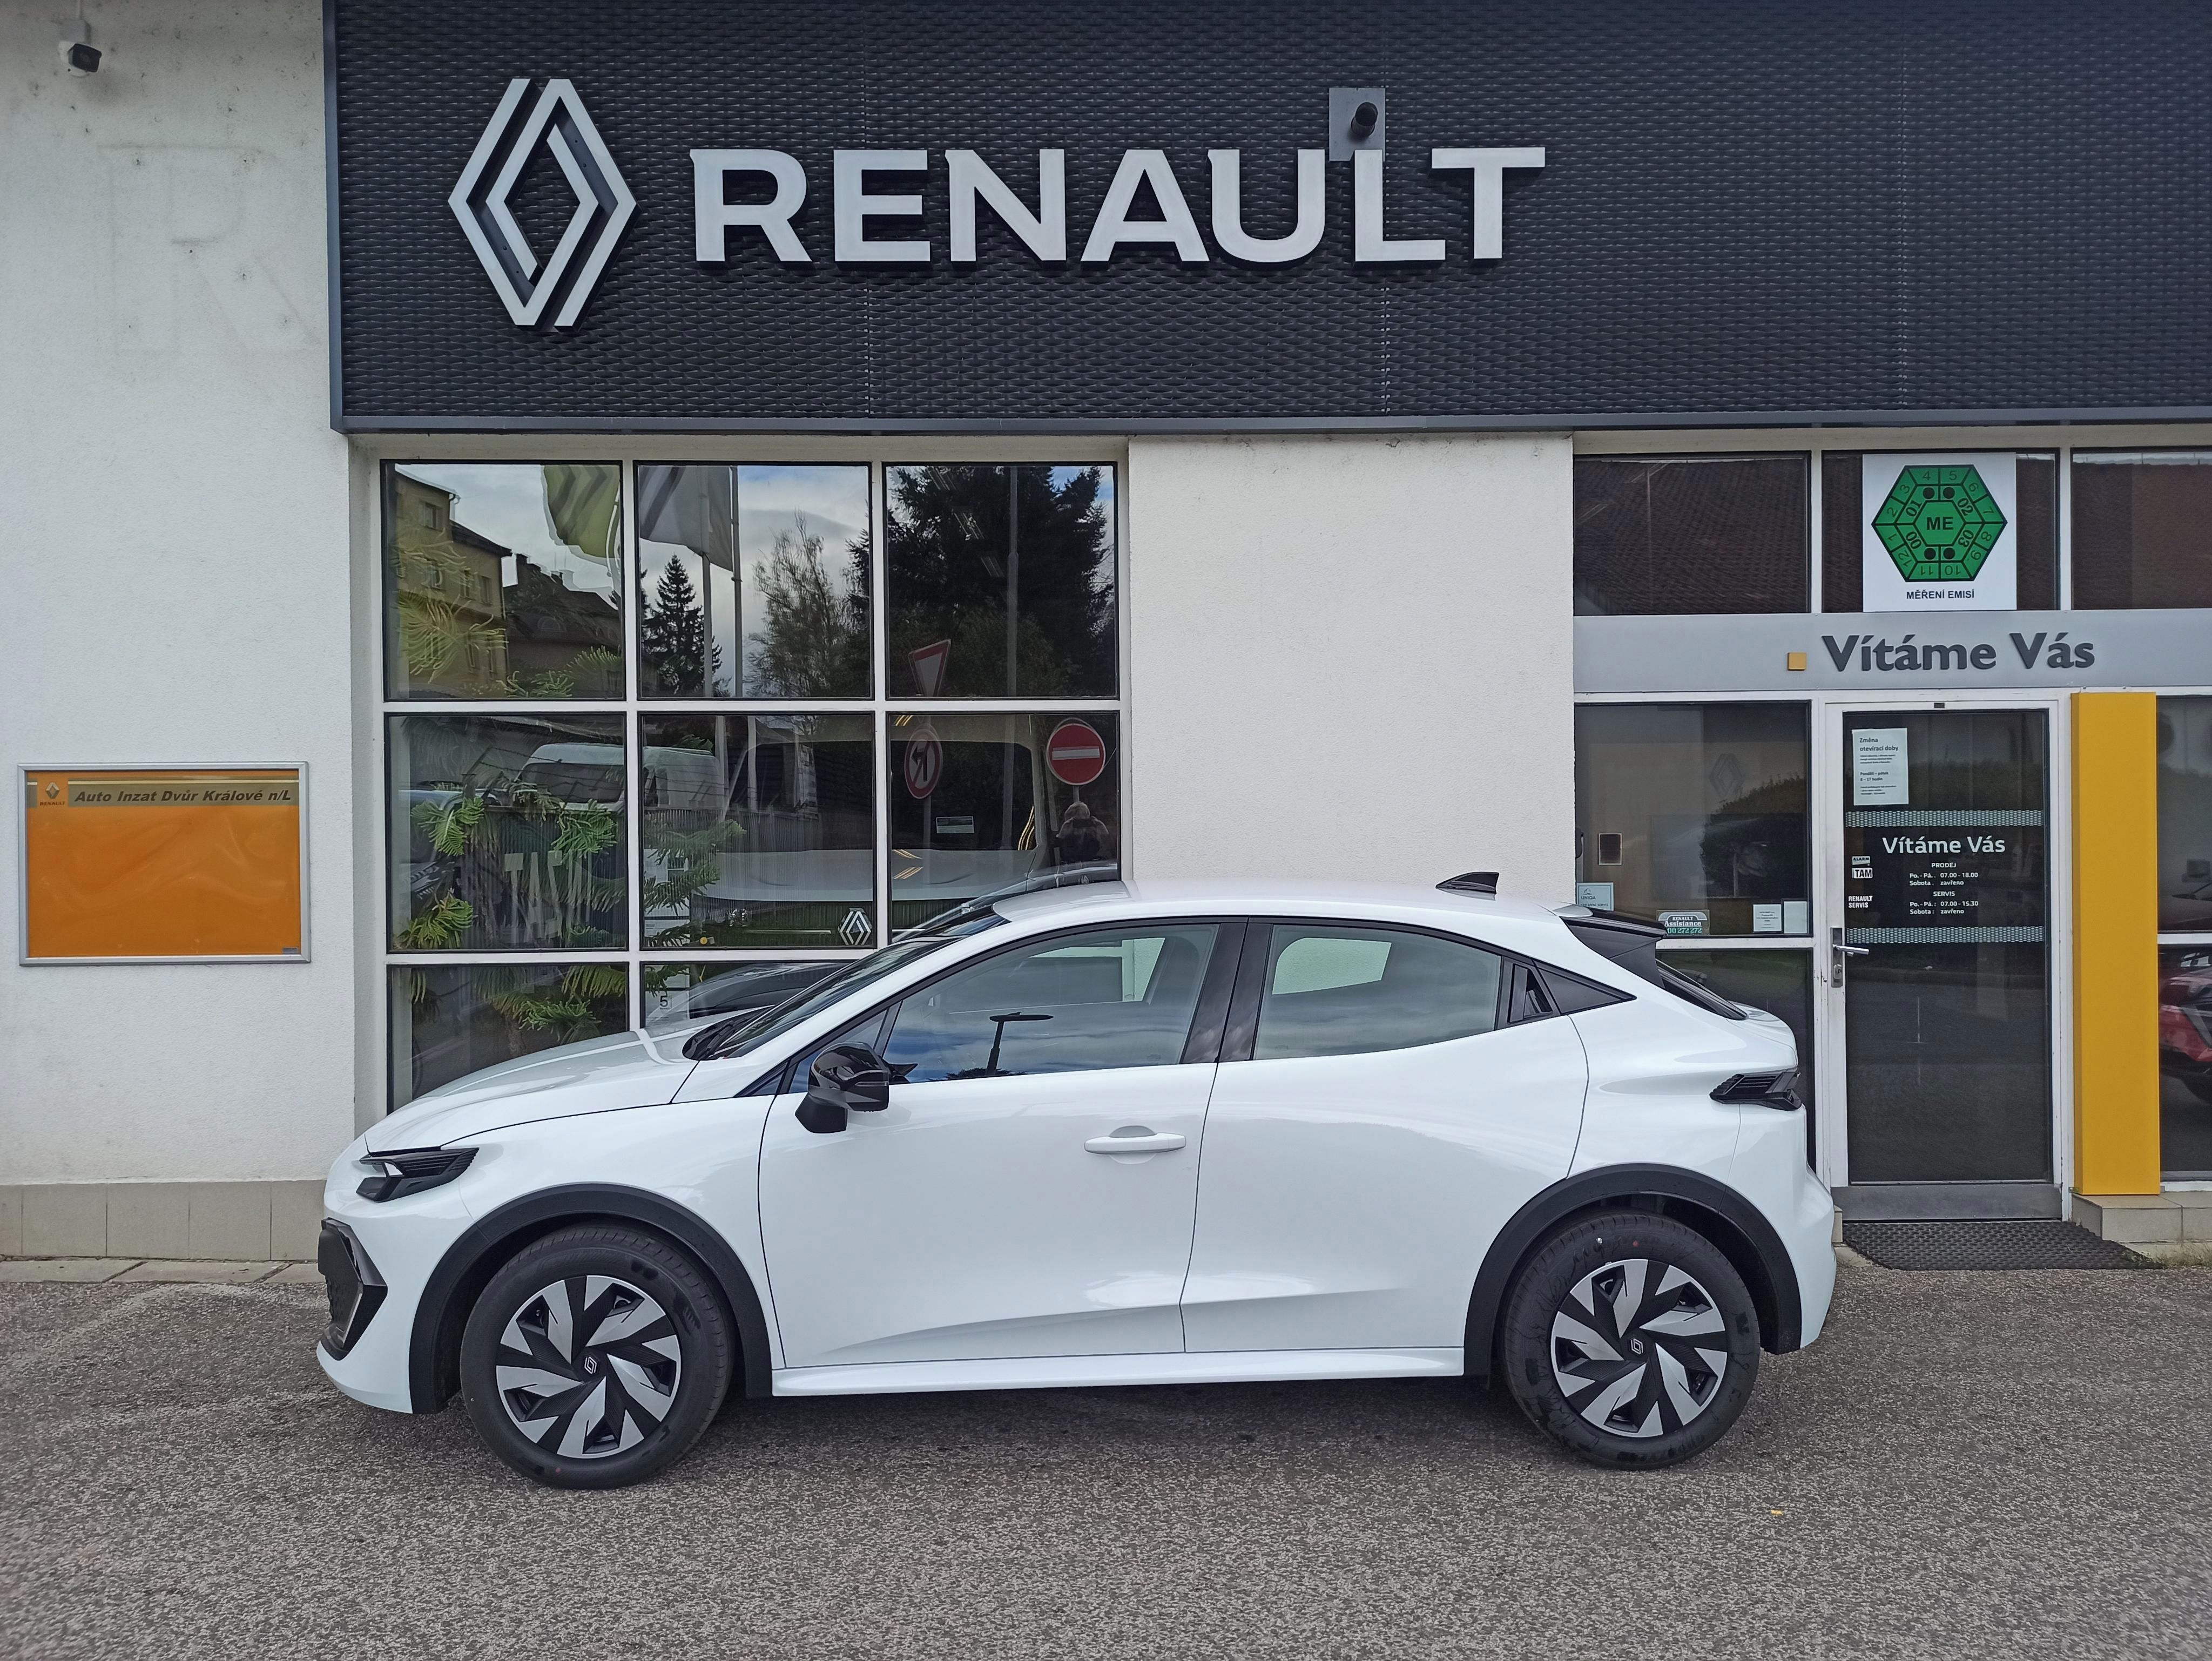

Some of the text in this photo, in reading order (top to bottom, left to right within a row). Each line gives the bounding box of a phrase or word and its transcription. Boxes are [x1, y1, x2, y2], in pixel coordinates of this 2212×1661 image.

[690, 147, 1546, 263] RENAULT
[1923, 471, 1931, 481] 4
[1949, 471, 1957, 481] 5
[1900, 484, 1910, 494] 3
[1887, 507, 1898, 517] 2
[1957, 498, 1973, 516] 02
[1983, 505, 1994, 514] 7
[1927, 516, 1953, 530] ME
[1905, 531, 1921, 549] 00
[1958, 530, 1974, 548] 03
[1981, 531, 1992, 541] 8
[1898, 550, 1912, 567] 12
[1921, 566, 1933, 576] 11
[1945, 565, 1961, 576] 10
[1906, 589, 1974, 599] MĚŘENÍ EMISÍ
[1821, 632, 2095, 672] Vítáme Vás
[75, 789, 291, 801] Auto Inzat Dvůr Králové n/L
[1883, 835, 2006, 854] Vítáme Vás
[1854, 869, 1872, 877] TAM
